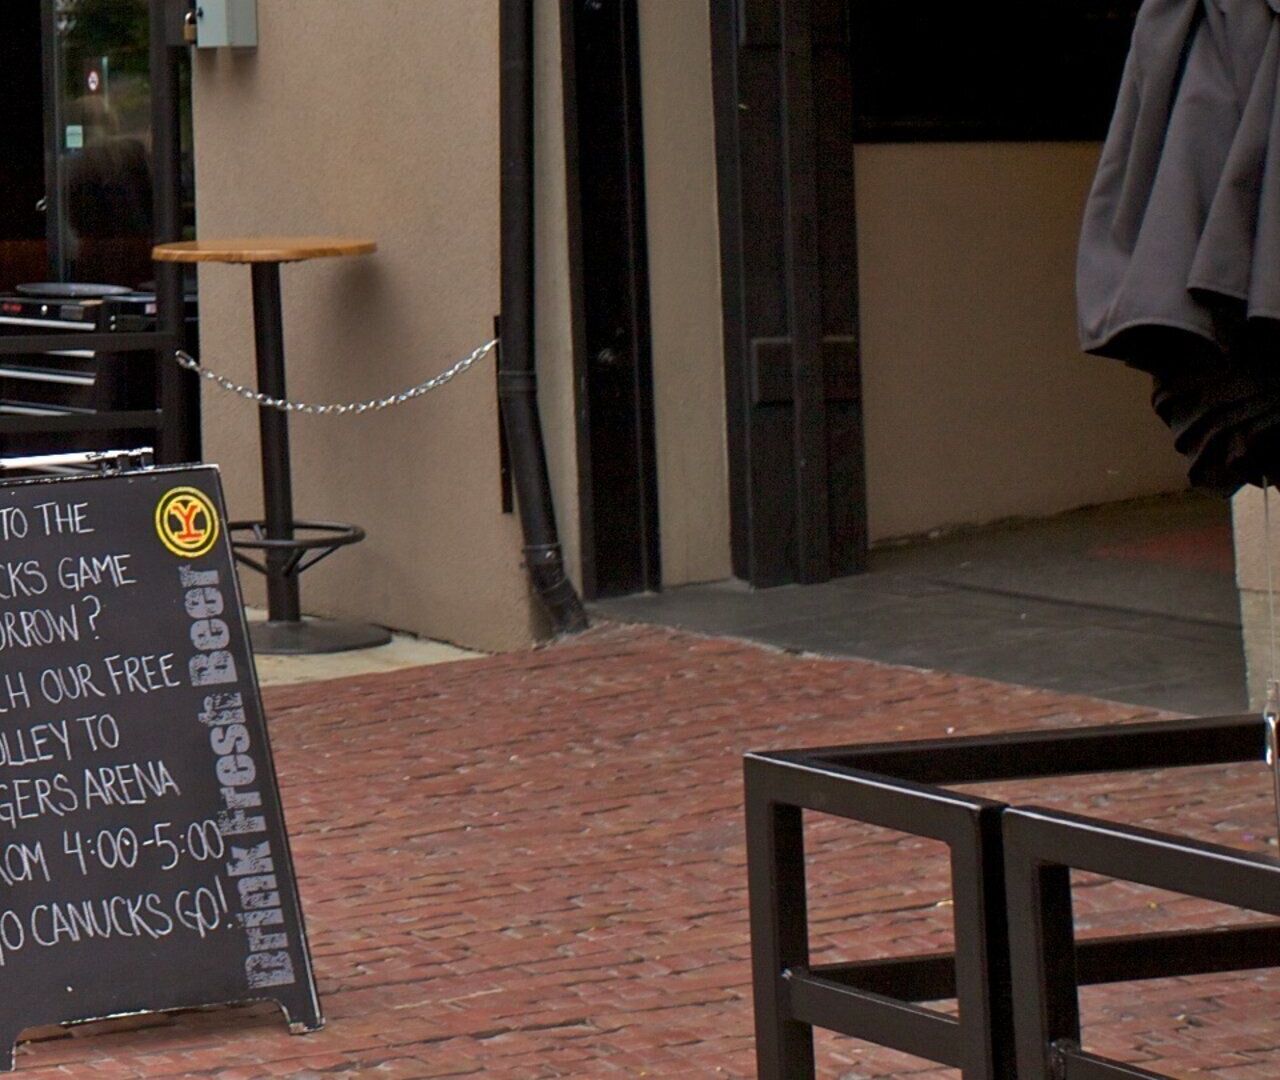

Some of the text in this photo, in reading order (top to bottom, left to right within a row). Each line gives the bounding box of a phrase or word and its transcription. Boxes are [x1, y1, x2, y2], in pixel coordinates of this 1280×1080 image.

[33, 502, 94, 536] THE
[58, 554, 137, 592] GAME
[40, 663, 106, 704] OUR
[103, 652, 181, 696] FREE
[77, 714, 119, 751] TO
[85, 760, 181, 810] ARENA
[178, 564, 295, 989] Drink Fresh Beer
[63, 819, 225, 875] 4:00-5:00
[31, 893, 173, 947] CANUCKS
[175, 875, 234, 938] GO!
